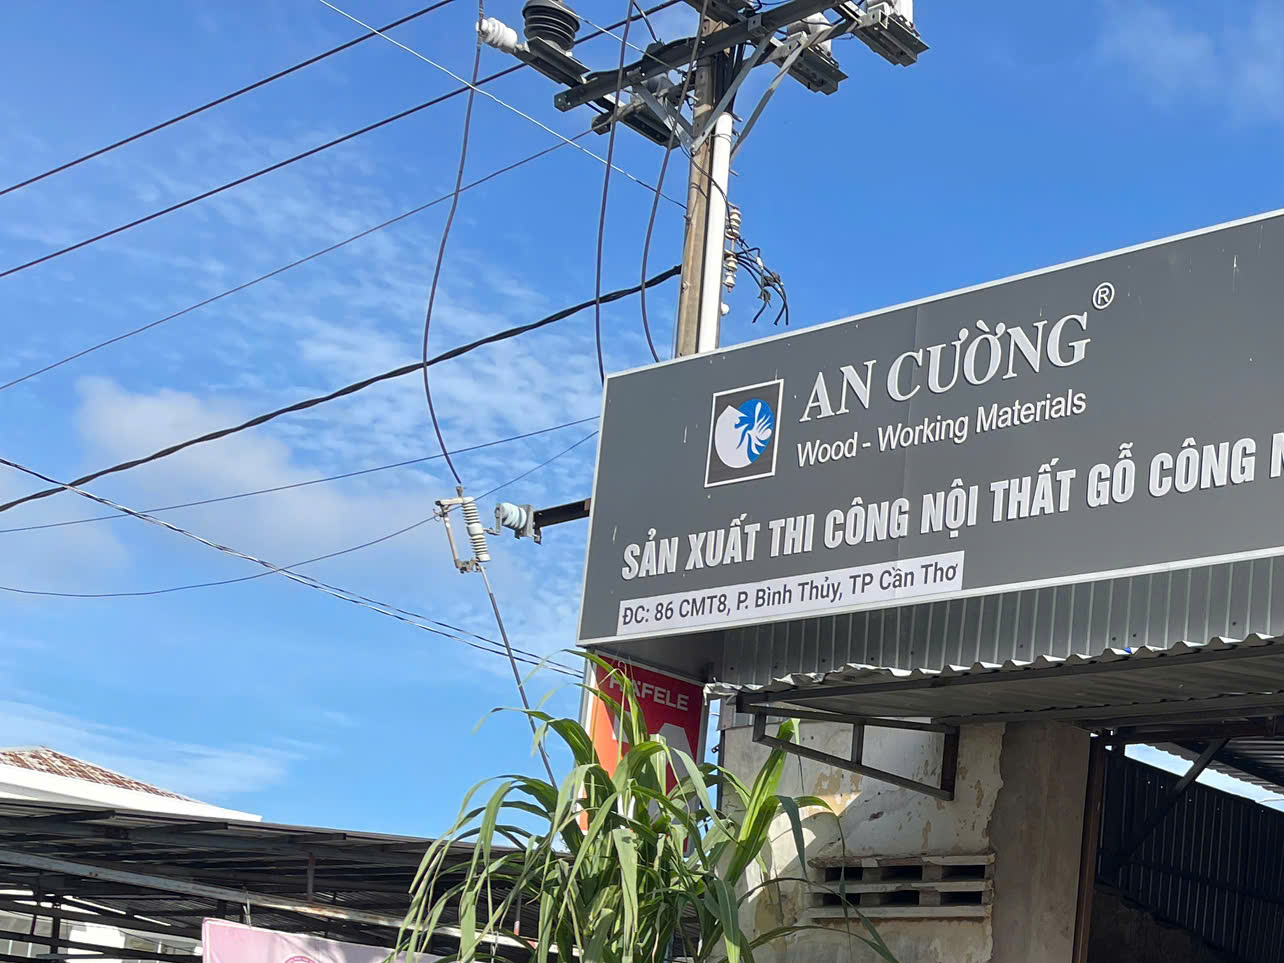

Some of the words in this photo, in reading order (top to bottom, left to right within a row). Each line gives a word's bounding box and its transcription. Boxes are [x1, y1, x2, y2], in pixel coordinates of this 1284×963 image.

[799, 359, 877, 423] AN
[886, 311, 1091, 402] CƯỜNG
[797, 431, 858, 468] Wood
[878, 415, 969, 452] Working
[976, 389, 1087, 433] Materials
[621, 527, 679, 580] SẢN
[685, 513, 760, 570] XUẤT
[768, 513, 815, 557] THI
[823, 497, 909, 549] CÔNG
[920, 478, 979, 538] NỘI
[989, 457, 1077, 523] THẤT
[1087, 442, 1136, 508] GỖ
[1149, 436, 1257, 498] CÔNG
[622, 605, 650, 625] ĐC:
[654, 601, 674, 621] 86
[679, 594, 731, 618] CMT8,
[736, 591, 749, 611] P.
[755, 584, 792, 608] Bình
[798, 576, 842, 602] Thủy,
[849, 572, 874, 594] TP
[879, 566, 915, 590] Cần
[921, 562, 959, 585] Thơ
